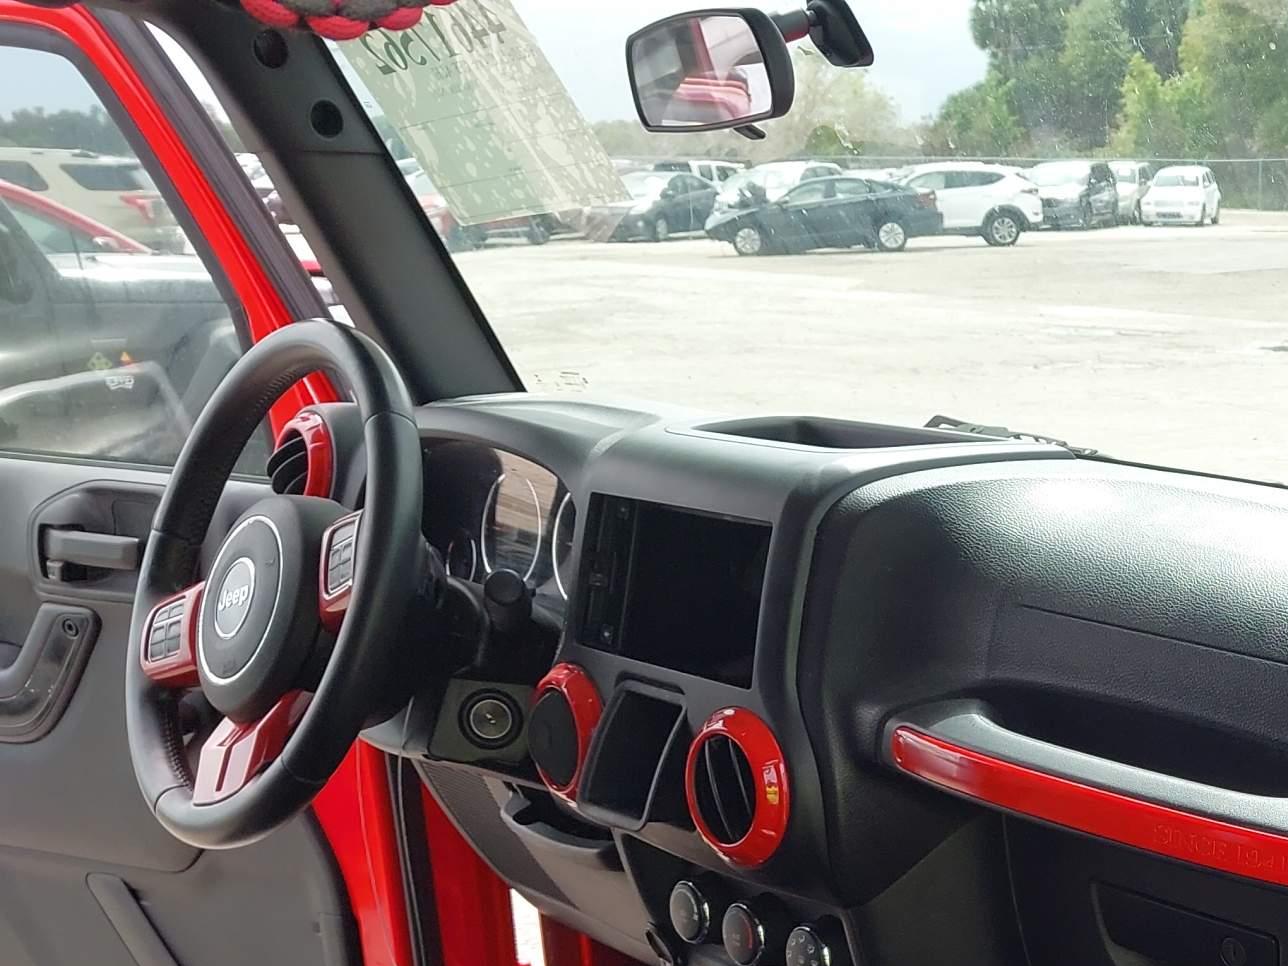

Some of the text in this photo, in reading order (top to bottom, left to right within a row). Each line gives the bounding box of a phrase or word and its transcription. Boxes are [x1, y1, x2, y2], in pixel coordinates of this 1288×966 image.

[218, 585, 249, 610] Jeep
[1153, 825, 1287, 871] SINCE 1941
